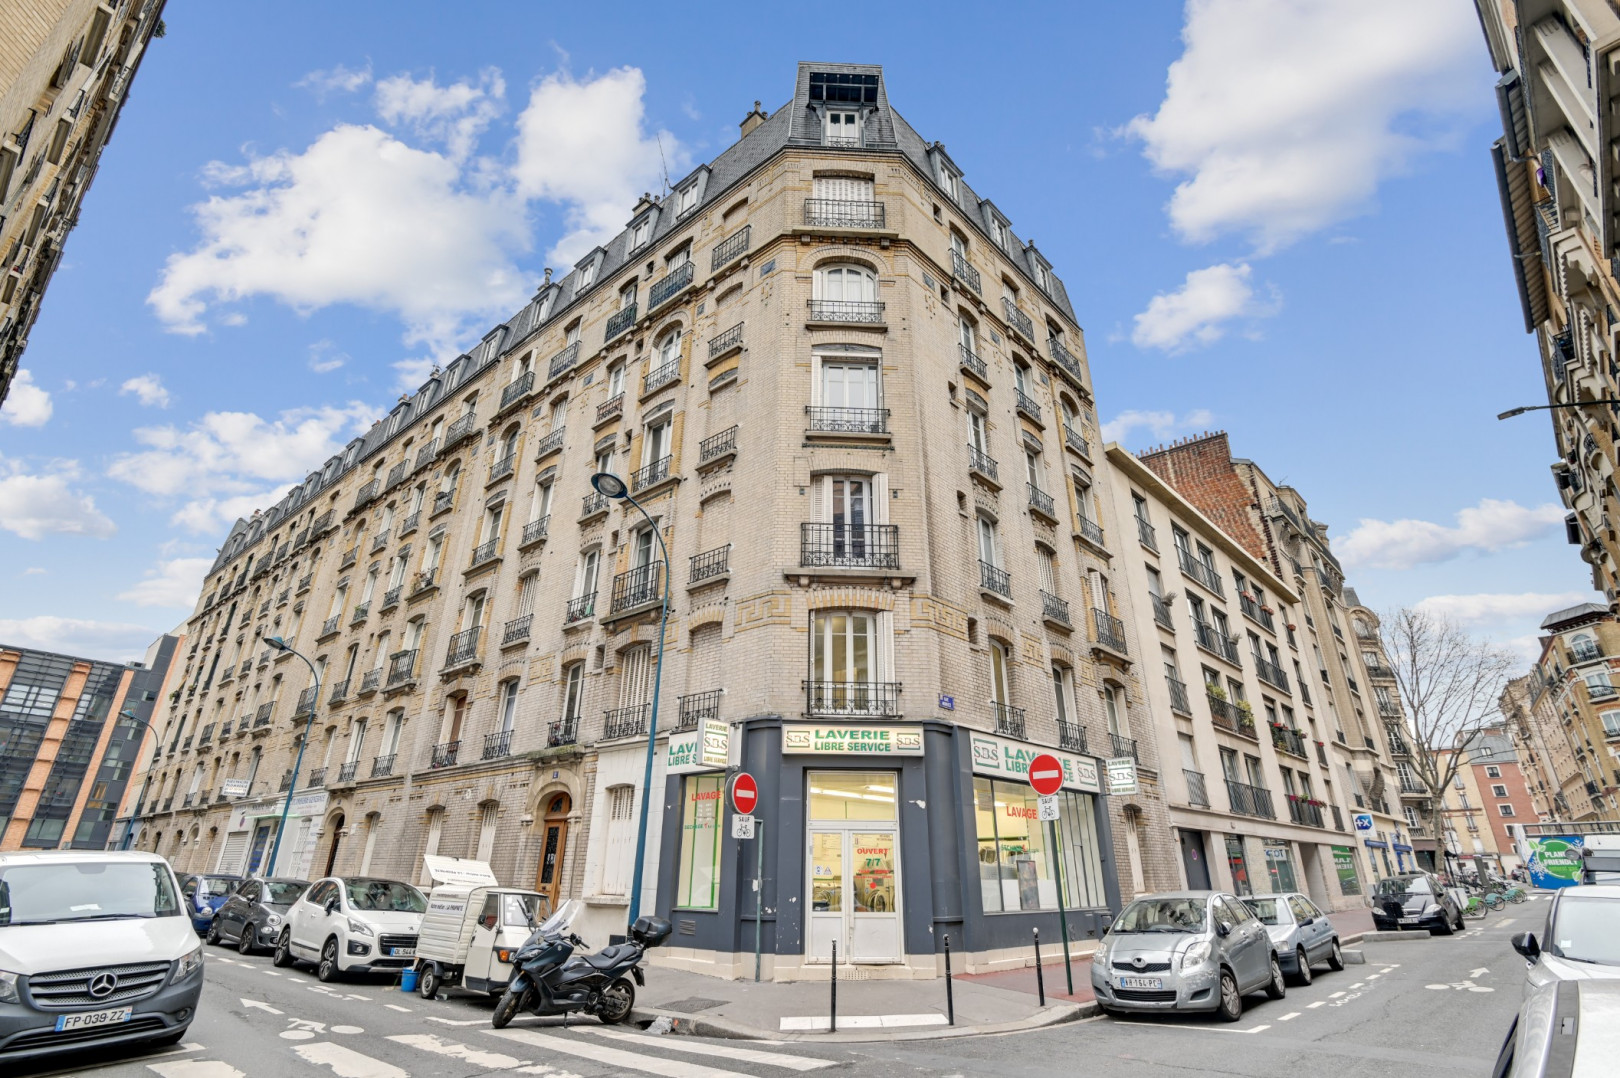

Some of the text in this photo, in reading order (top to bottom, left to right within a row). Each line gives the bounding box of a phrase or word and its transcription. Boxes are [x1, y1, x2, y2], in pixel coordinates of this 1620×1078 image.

[815, 729, 890, 740] LAVERIE
[814, 741, 891, 752] LIBRE SERVICE
[668, 754, 690, 766] LIBRE
[1005, 760, 1030, 774] LIBR
[691, 790, 722, 802] LAVAGE
[1006, 806, 1038, 820] LAVAGE
[866, 858, 881, 867] 7/7
[65, 1010, 125, 1028] FP-039-ZZ
